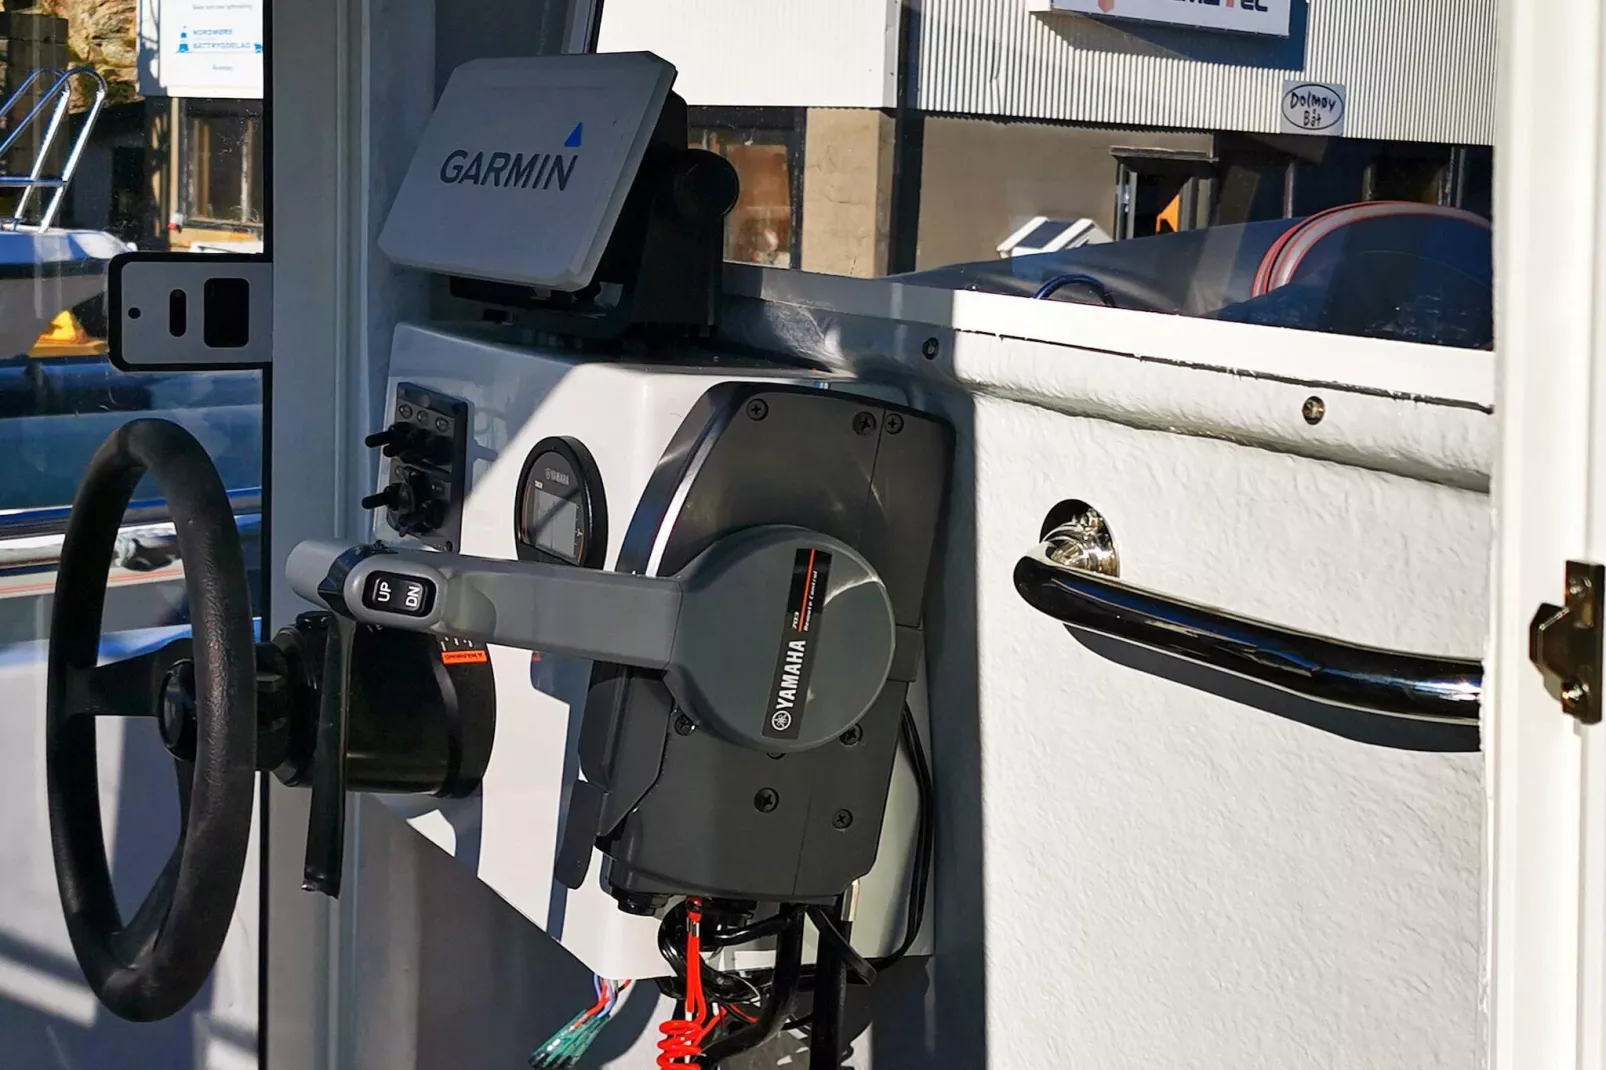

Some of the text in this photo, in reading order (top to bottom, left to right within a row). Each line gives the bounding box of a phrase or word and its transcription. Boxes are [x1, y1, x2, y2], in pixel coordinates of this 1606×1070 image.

[1303, 108, 1322, 128] Båt
[440, 149, 579, 191] GARMIN
[377, 581, 392, 602] UP
[405, 585, 420, 607] DN
[803, 570, 818, 632] Remote Control
[792, 611, 800, 630] 703
[775, 640, 807, 709] YAMAHA
